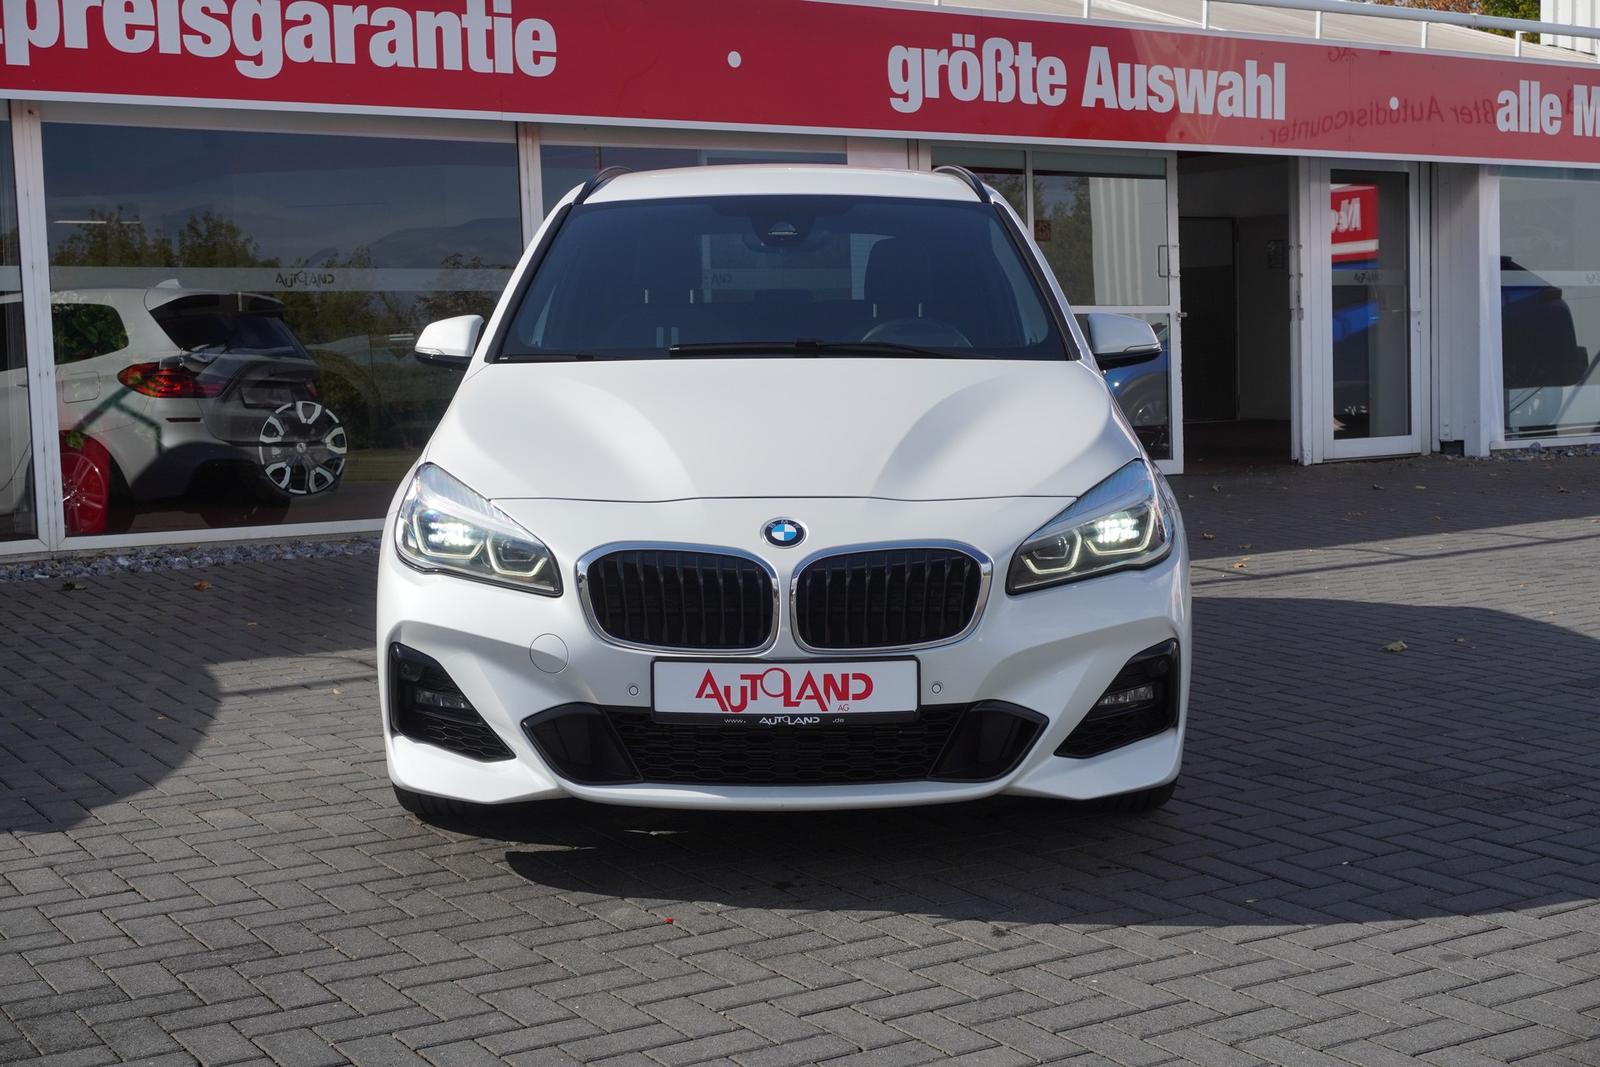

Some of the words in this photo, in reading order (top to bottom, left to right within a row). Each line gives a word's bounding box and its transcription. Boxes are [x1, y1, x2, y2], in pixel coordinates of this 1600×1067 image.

[0, 0, 556, 79] preisgarantie
[888, 33, 1067, 113] größte
[1082, 46, 1287, 120] Auswahl
[1496, 79, 1562, 136] alle
[695, 667, 874, 714] AUTOLAND
[837, 703, 850, 712] AG
[759, 715, 821, 726] AUTOLAND
